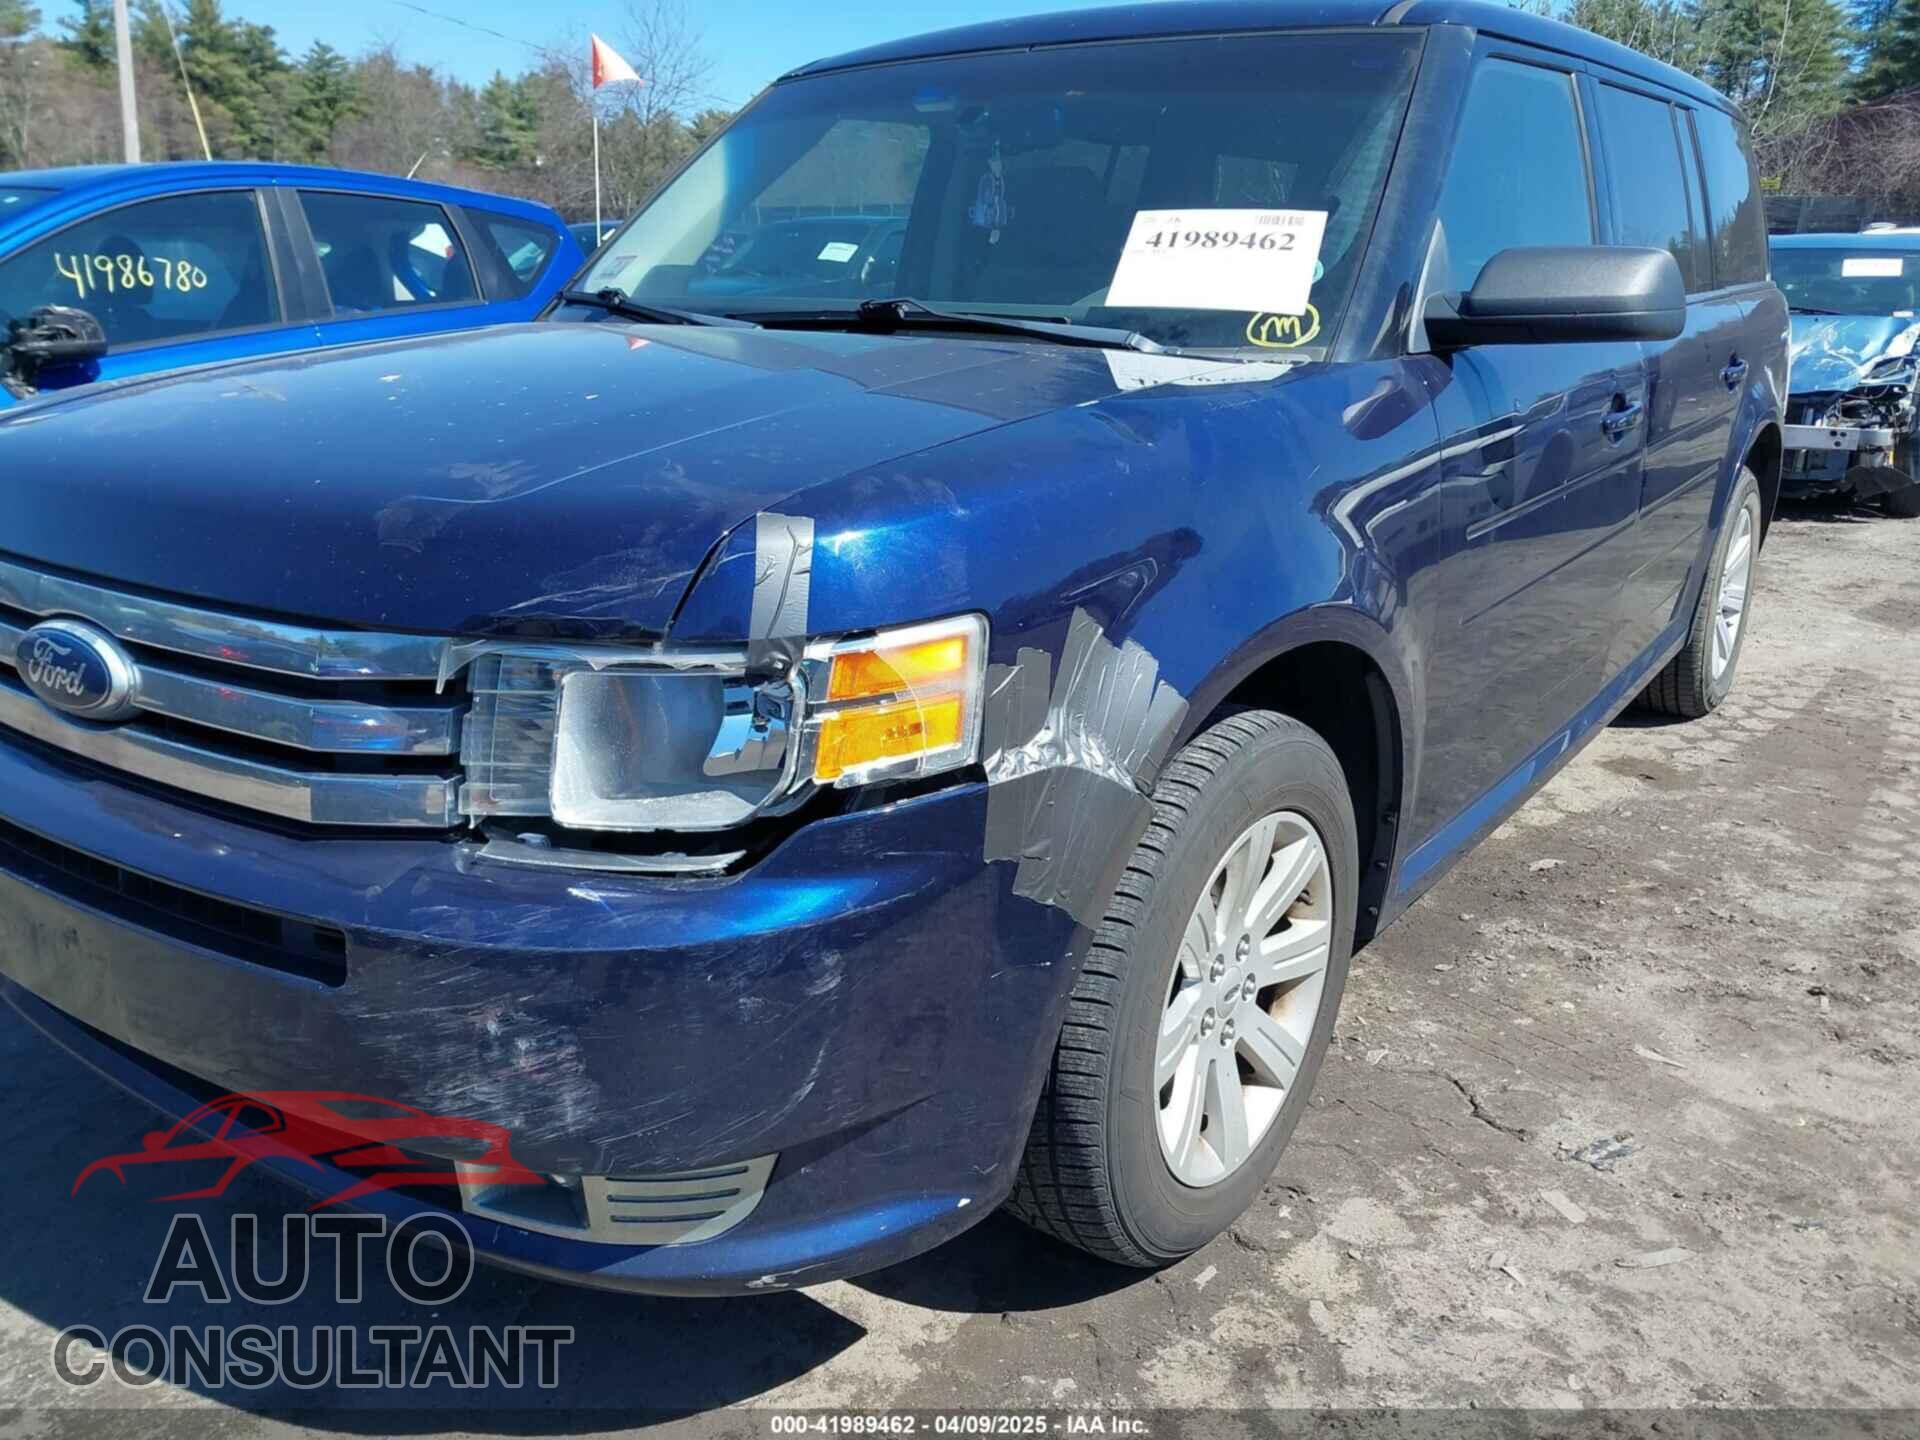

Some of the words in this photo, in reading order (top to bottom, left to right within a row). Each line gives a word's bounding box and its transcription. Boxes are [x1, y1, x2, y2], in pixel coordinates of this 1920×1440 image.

[1146, 231, 1296, 251] 41989462
[54, 252, 207, 299] 41986780
[28, 637, 87, 697] Ford
